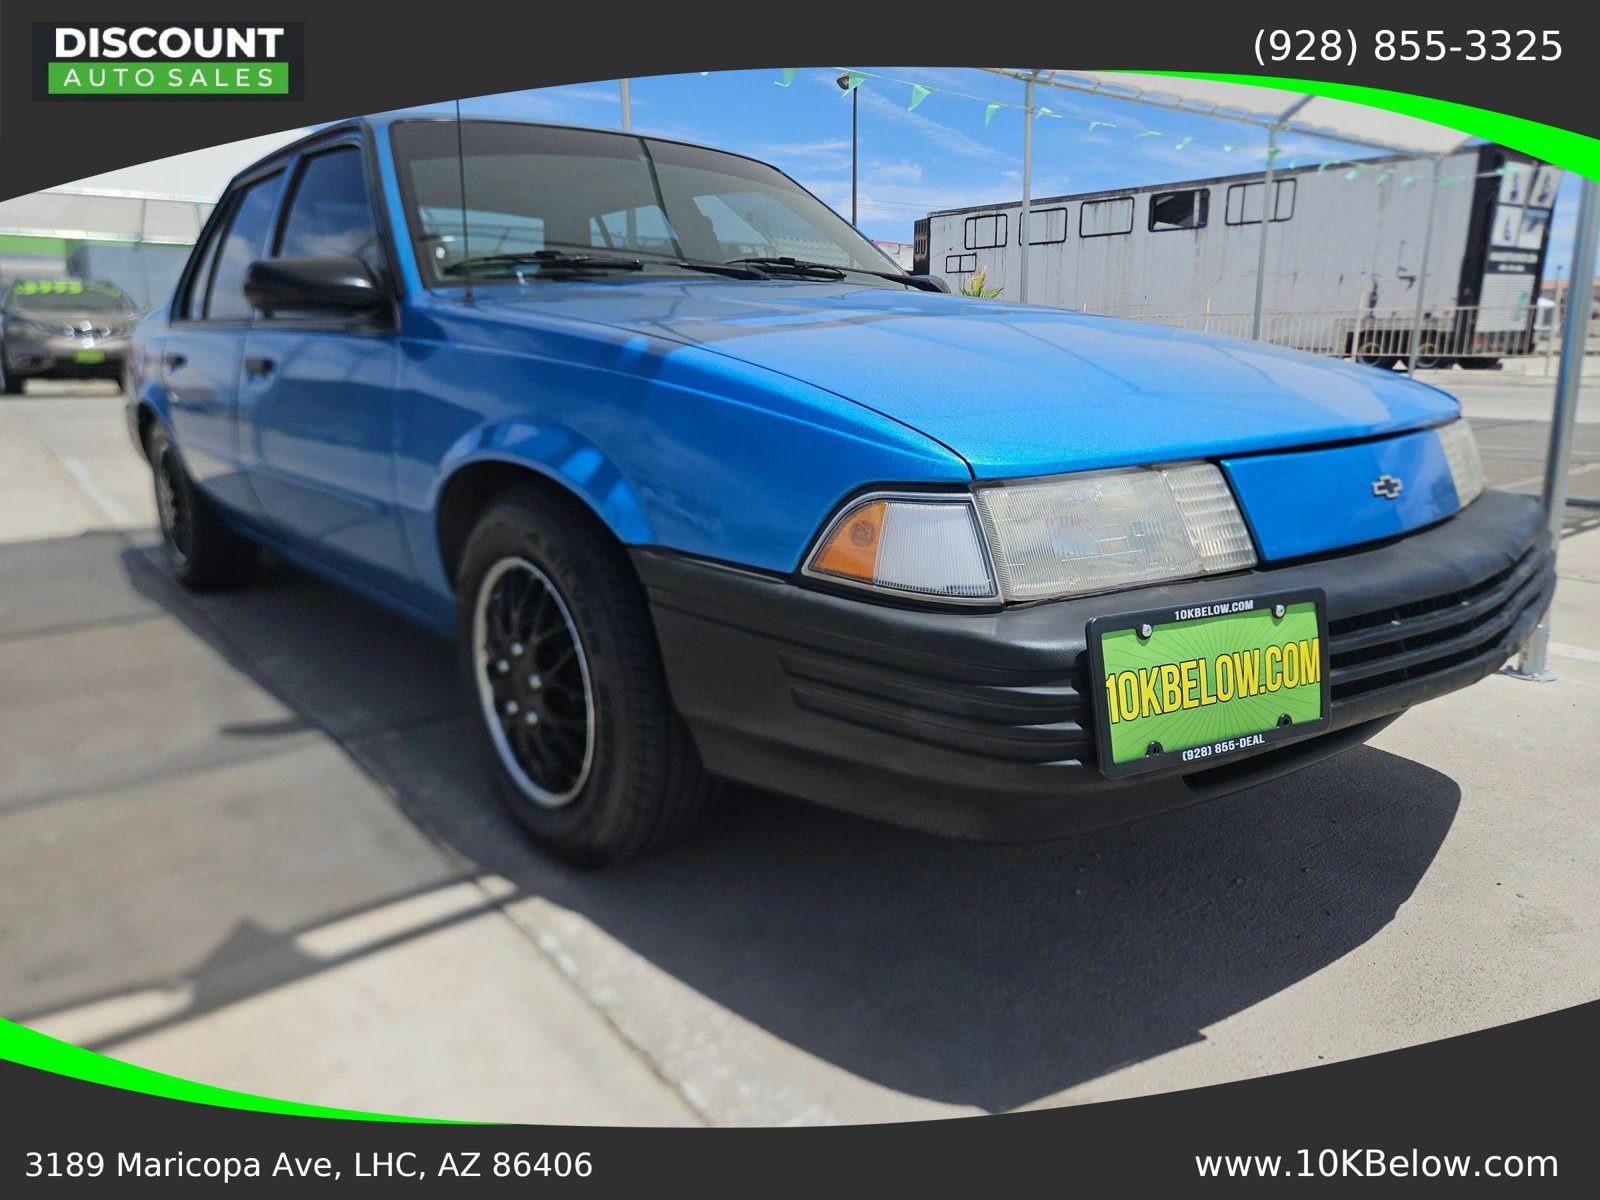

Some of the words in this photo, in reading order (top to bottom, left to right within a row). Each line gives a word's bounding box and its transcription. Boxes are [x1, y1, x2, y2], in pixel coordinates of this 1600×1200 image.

[1175, 600, 1254, 621] 10KBELOW.COM
[1106, 638, 1320, 724] 10KBELOW.COM
[1182, 745, 1212, 761] (928)
[1214, 734, 1265, 754] 855-DEAL
